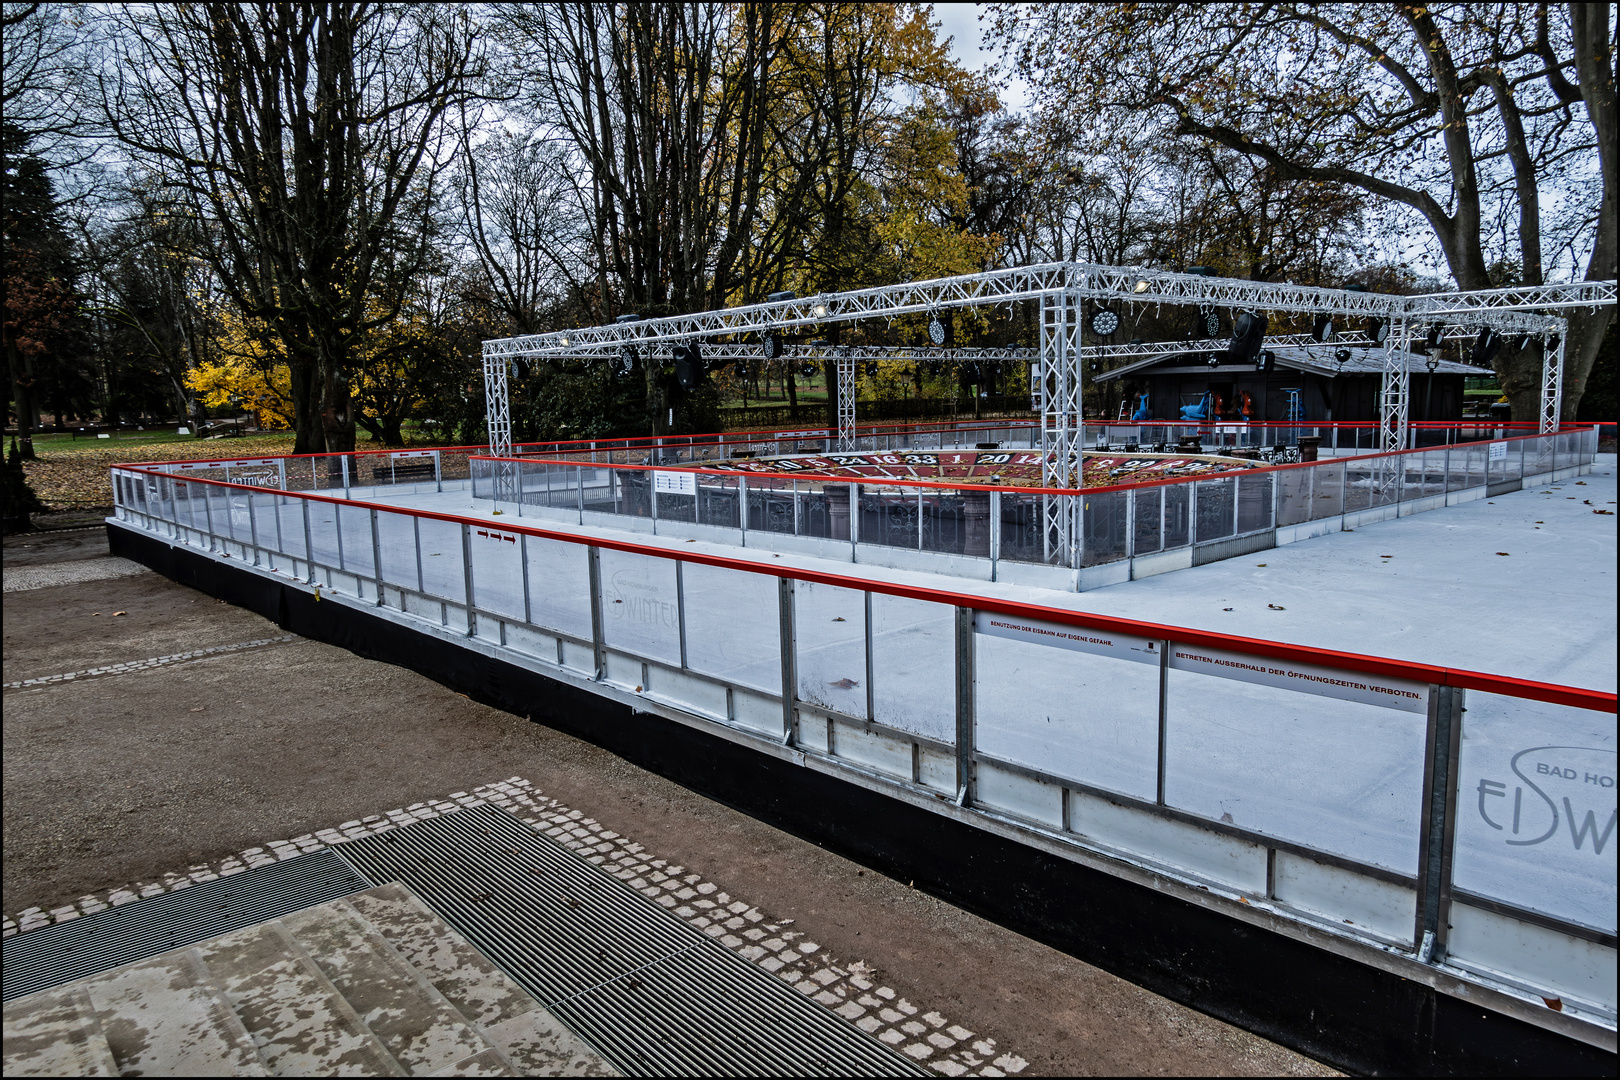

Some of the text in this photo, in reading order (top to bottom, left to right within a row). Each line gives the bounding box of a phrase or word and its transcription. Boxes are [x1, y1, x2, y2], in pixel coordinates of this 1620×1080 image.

[832, 456, 870, 465] 24
[870, 455, 900, 464] 16
[905, 454, 938, 464] 33
[952, 454, 962, 464] 1
[977, 454, 1010, 464] 20
[1014, 454, 1043, 465] 14
[990, 621, 1021, 631] BENUTZUNG
[1032, 627, 1055, 637] EISBAHN
[1068, 633, 1088, 642] EIGENE
[1088, 637, 1114, 647] GEFAHR.
[1175, 652, 1422, 700] BETRETEN AUSSERHALB DER ÖFFNUNGSZEITEN VERBOTEN.
[1536, 762, 1617, 790] BAD HO
